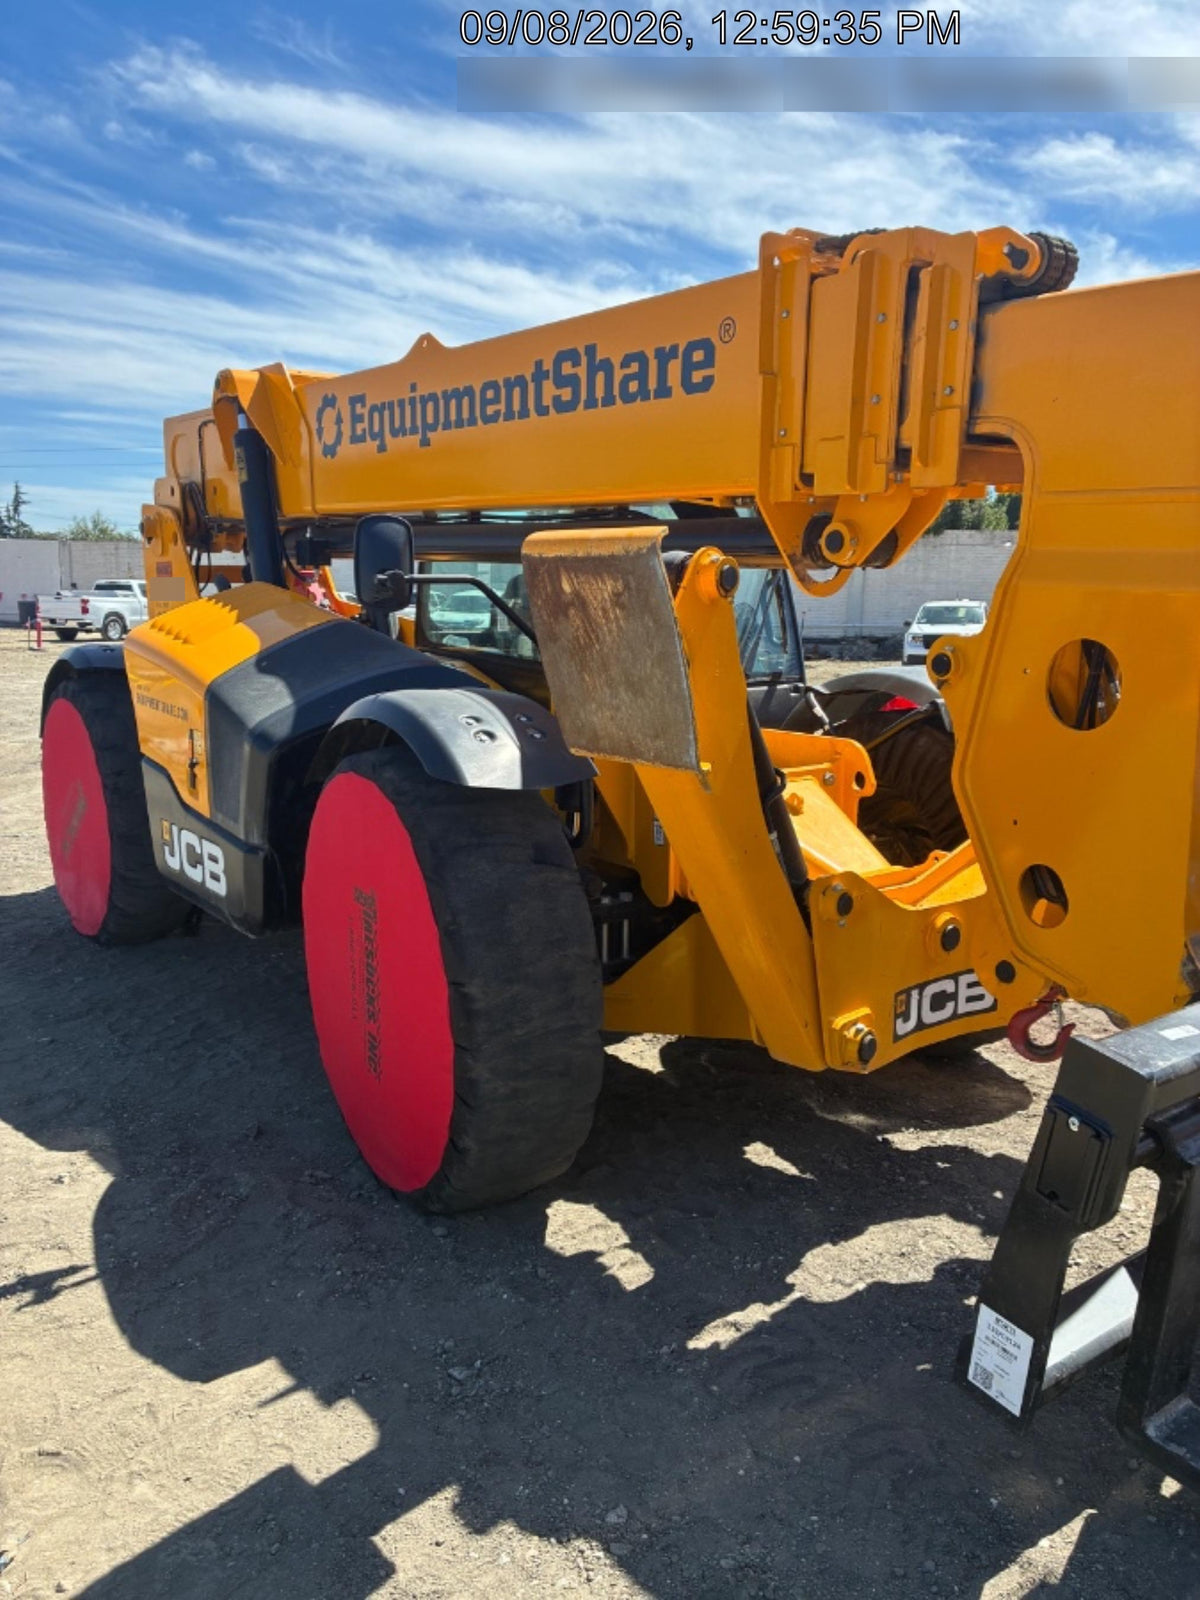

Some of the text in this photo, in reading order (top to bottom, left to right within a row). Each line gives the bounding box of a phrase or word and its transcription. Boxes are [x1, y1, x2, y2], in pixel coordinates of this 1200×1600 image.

[348, 337, 716, 454] EquipmentShare
[163, 824, 228, 897] JCB
[895, 973, 995, 1036] JCB
